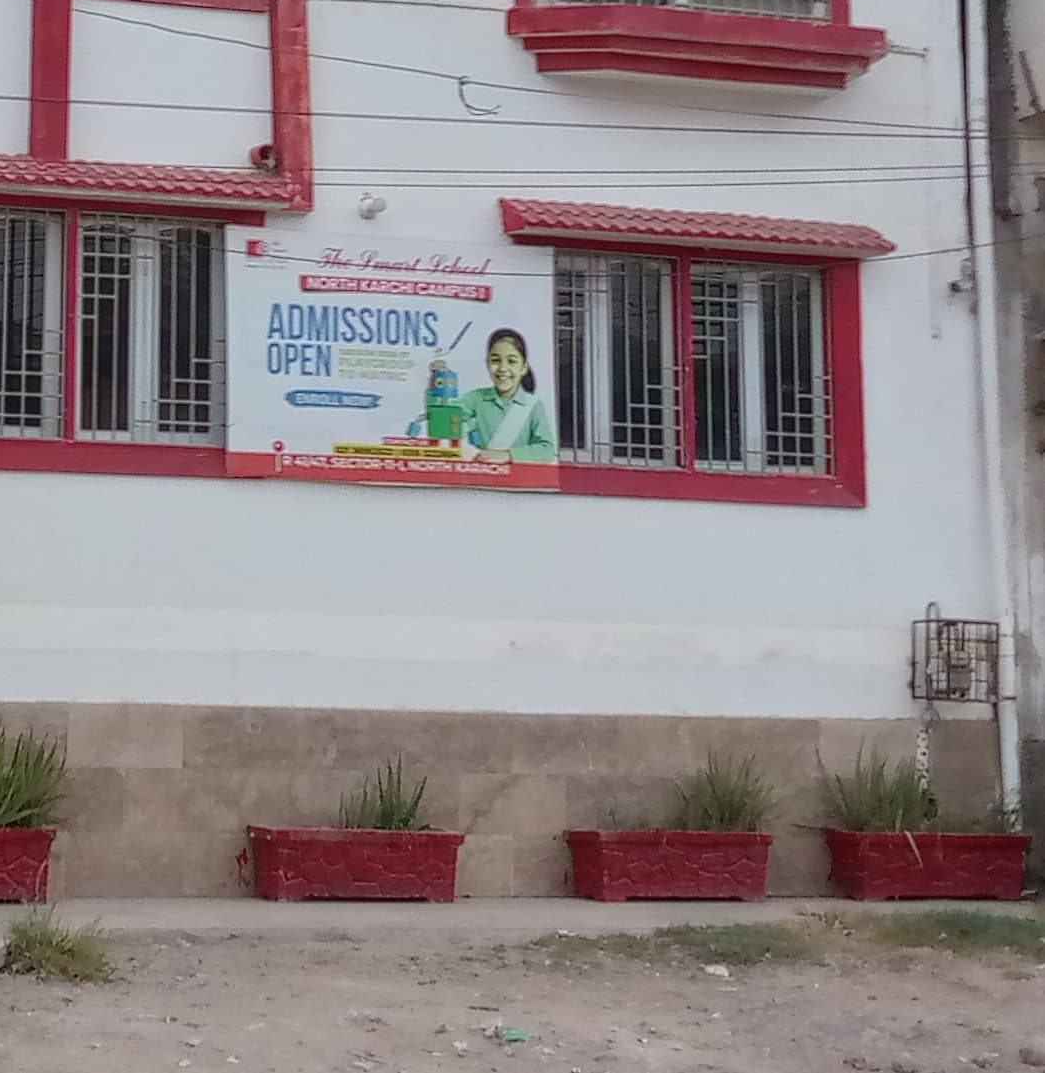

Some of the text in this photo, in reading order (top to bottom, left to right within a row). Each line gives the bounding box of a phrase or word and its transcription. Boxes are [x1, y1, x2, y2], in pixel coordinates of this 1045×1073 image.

[318, 247, 492, 276] The Smart School
[306, 277, 356, 290] NORTH
[415, 282, 478, 298] CAMPUS
[267, 303, 439, 347] ADMISSIONS
[267, 342, 332, 377] OPEN
